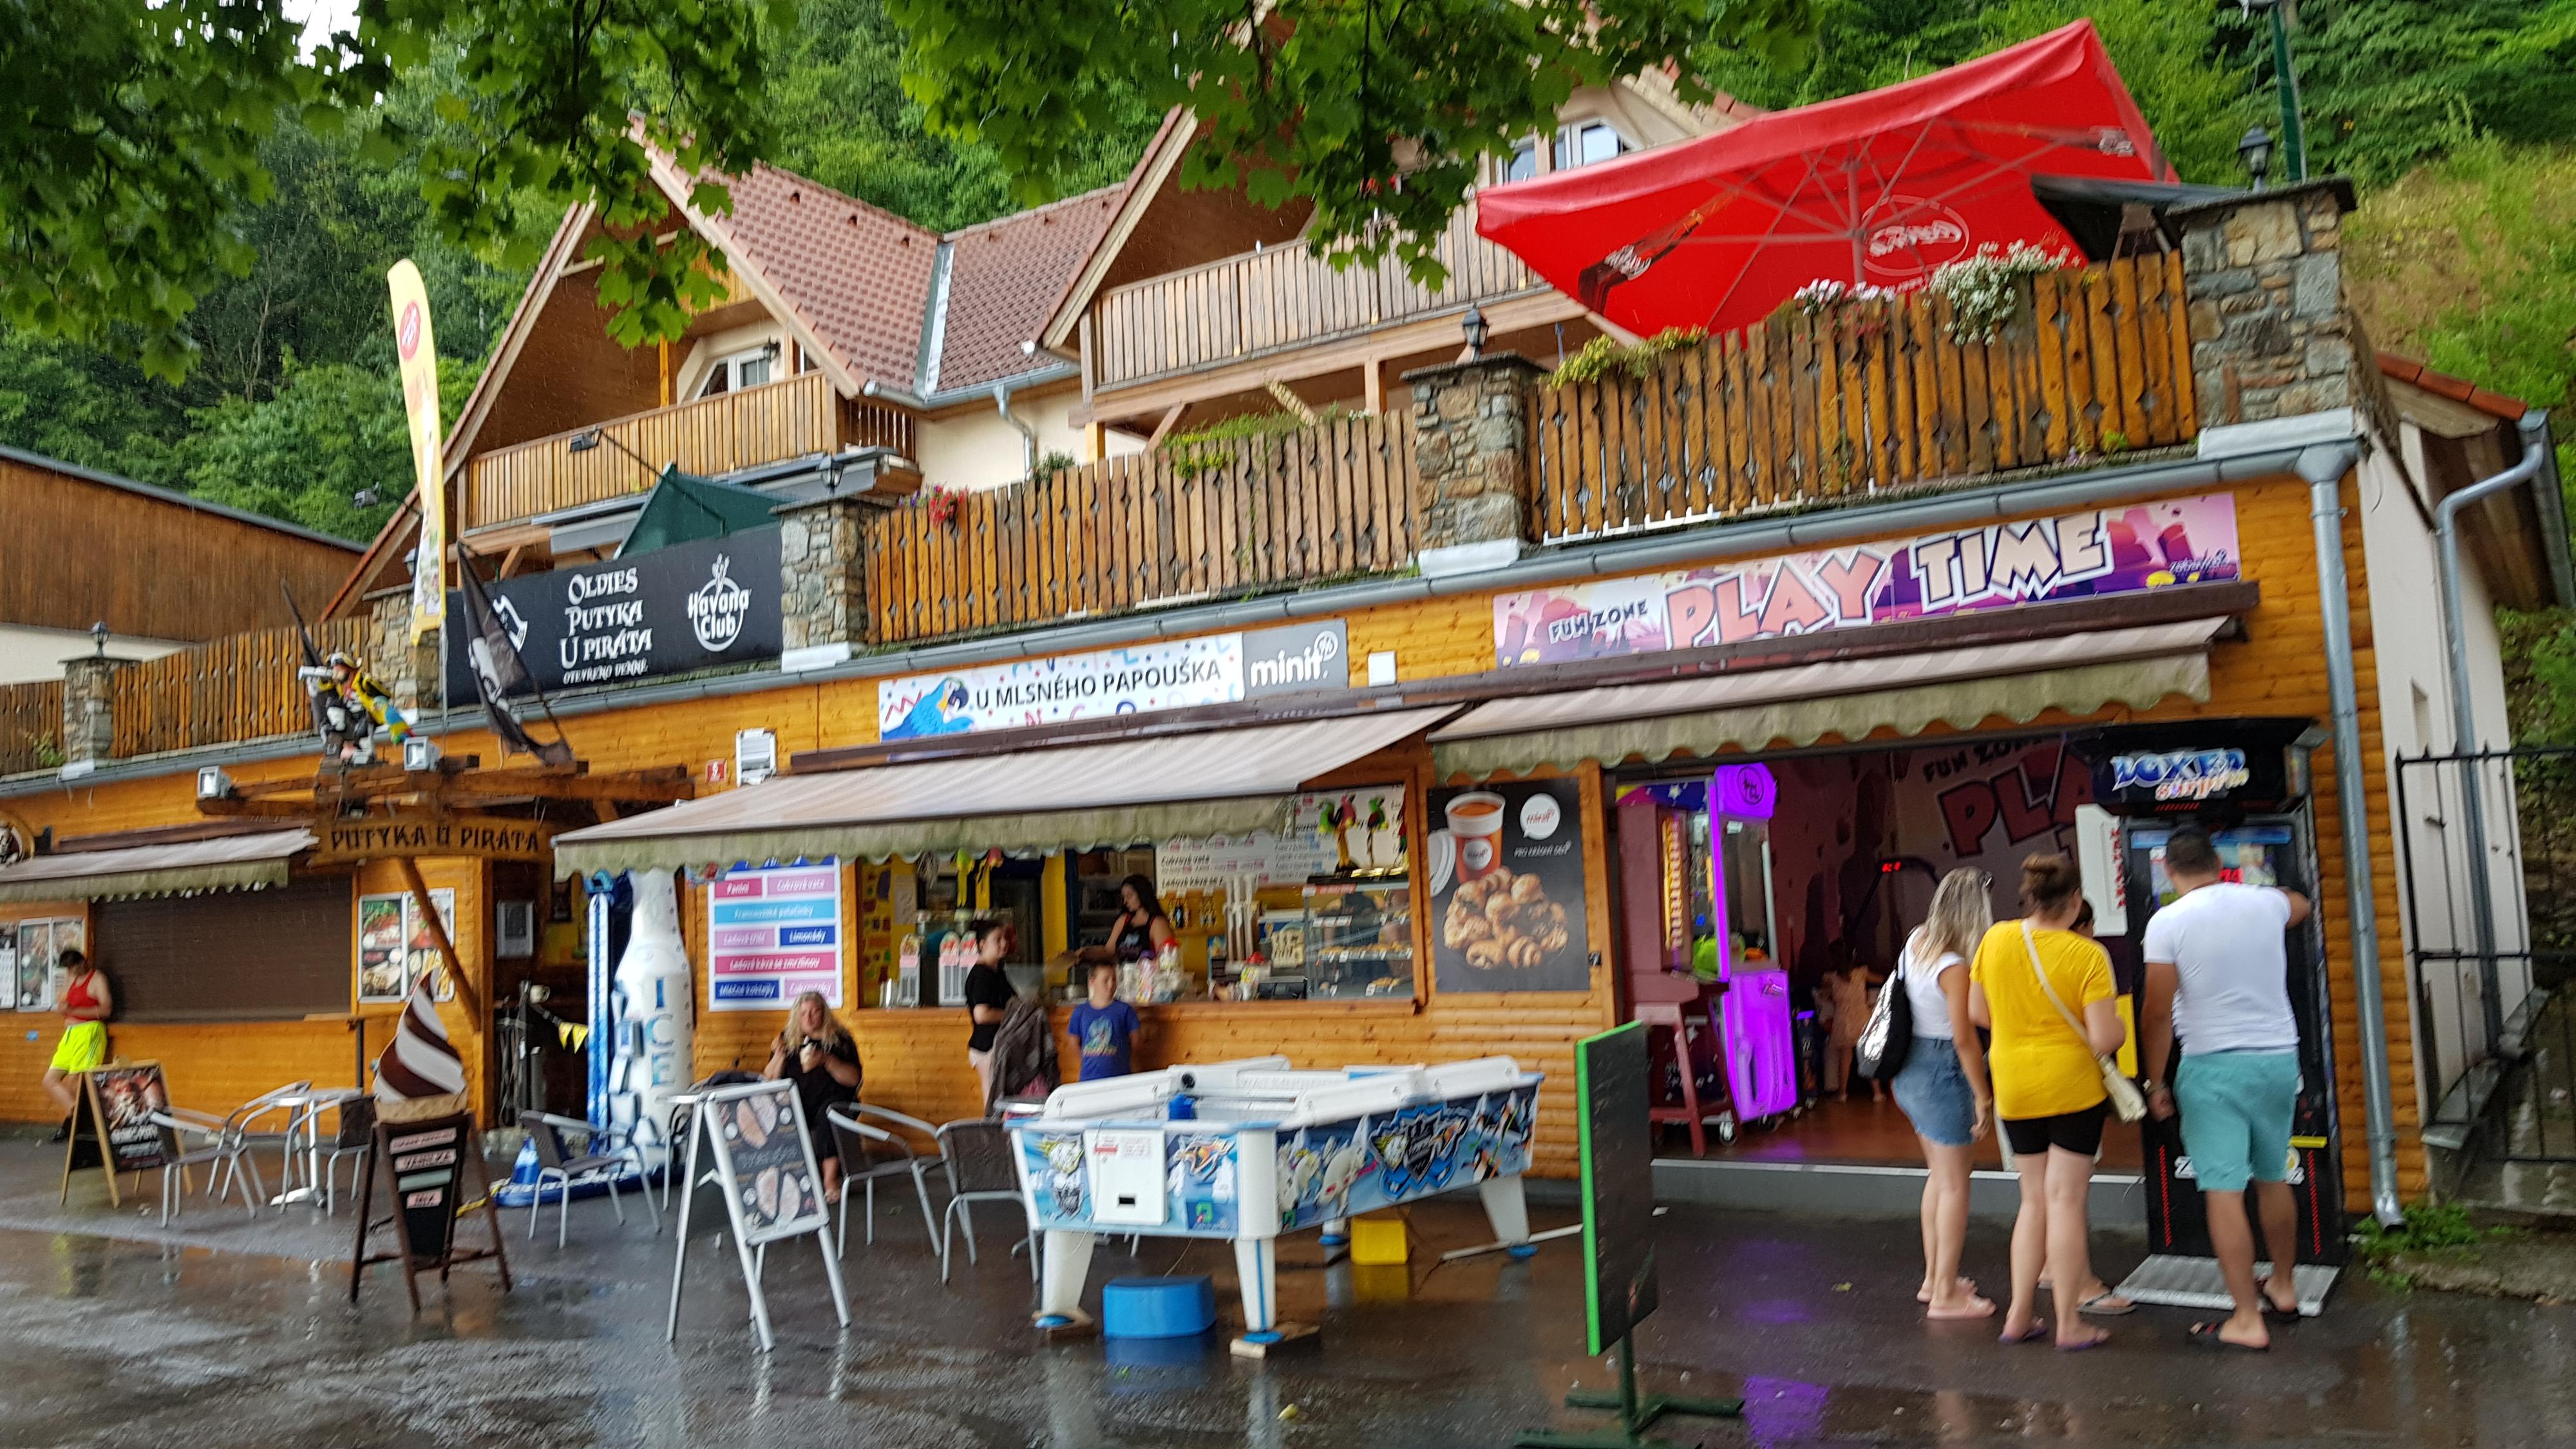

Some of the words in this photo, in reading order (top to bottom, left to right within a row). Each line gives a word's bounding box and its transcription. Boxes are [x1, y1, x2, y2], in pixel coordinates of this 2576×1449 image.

[568, 567, 638, 605] OLDIES
[1665, 547, 1886, 651] PLAY
[1909, 510, 2116, 612] TIME
[565, 599, 644, 637] PUTYKA
[688, 589, 750, 619] Havana
[1590, 598, 1648, 632] ZONE
[700, 612, 736, 640] Club
[559, 636, 580, 670] U
[583, 628, 653, 661] PIRÁTA
[976, 688, 989, 710] U
[996, 673, 1095, 709] MLSNÉHO
[1103, 656, 1222, 696] PAPOUŠKA
[330, 825, 426, 851] PUTYKA
[459, 824, 540, 853] PIRÁTA
[645, 978, 676, 1089] ICE
